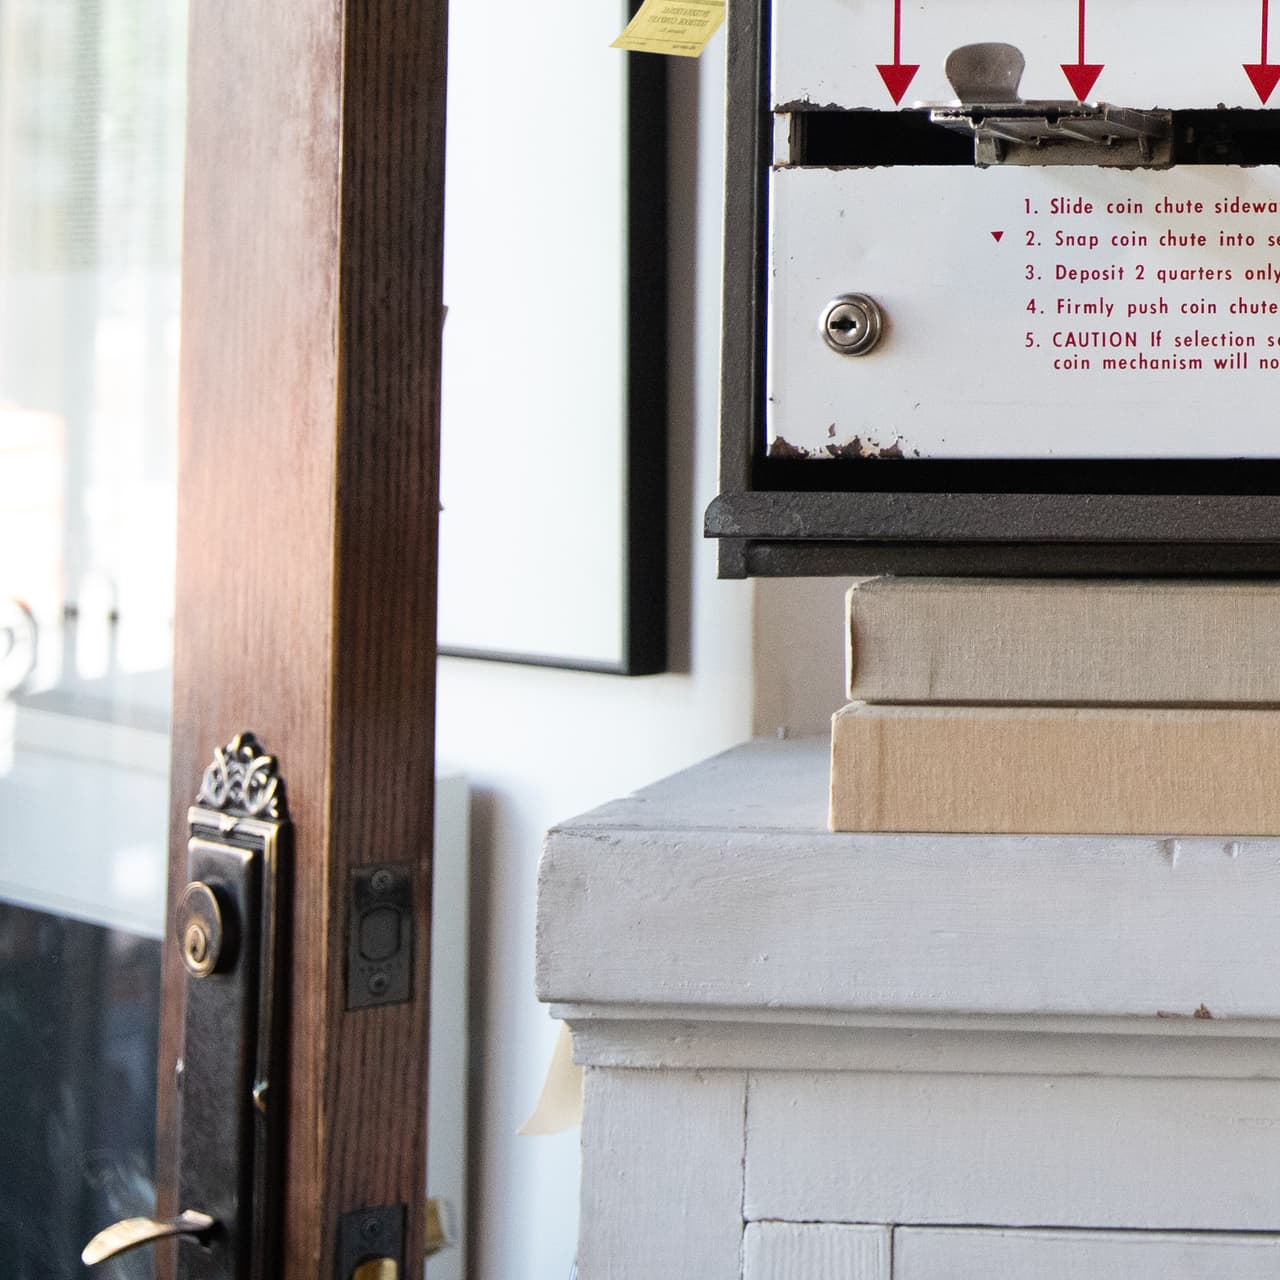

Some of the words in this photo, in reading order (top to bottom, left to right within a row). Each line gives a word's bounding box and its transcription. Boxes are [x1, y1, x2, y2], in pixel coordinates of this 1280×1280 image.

[1025, 199, 1038, 214] 1.
[1051, 197, 1093, 214] Slide
[1107, 198, 1142, 214] coin
[1155, 196, 1203, 213] chute
[1026, 231, 1041, 246] 2.
[1056, 230, 1098, 249] Snap
[1112, 231, 1147, 246] coin
[1160, 229, 1206, 246] chute
[1220, 231, 1254, 246] into
[1026, 265, 1041, 280] 3.
[1056, 265, 1124, 283] Deposit
[1136, 265, 1144, 280] 2
[1157, 267, 1232, 283] quarters
[1026, 299, 1044, 314] 4.
[1058, 297, 1113, 317] Firmly
[1128, 297, 1168, 317] push
[1181, 298, 1216, 314] coin
[1230, 297, 1278, 314] chute
[1025, 332, 1040, 347] 5.
[1053, 332, 1136, 347] CAUTION
[1151, 330, 1161, 347] If
[1175, 330, 1255, 347] selection
[1054, 354, 1089, 369] coin
[1103, 352, 1202, 369] mechanism
[1214, 352, 1247, 369] will
